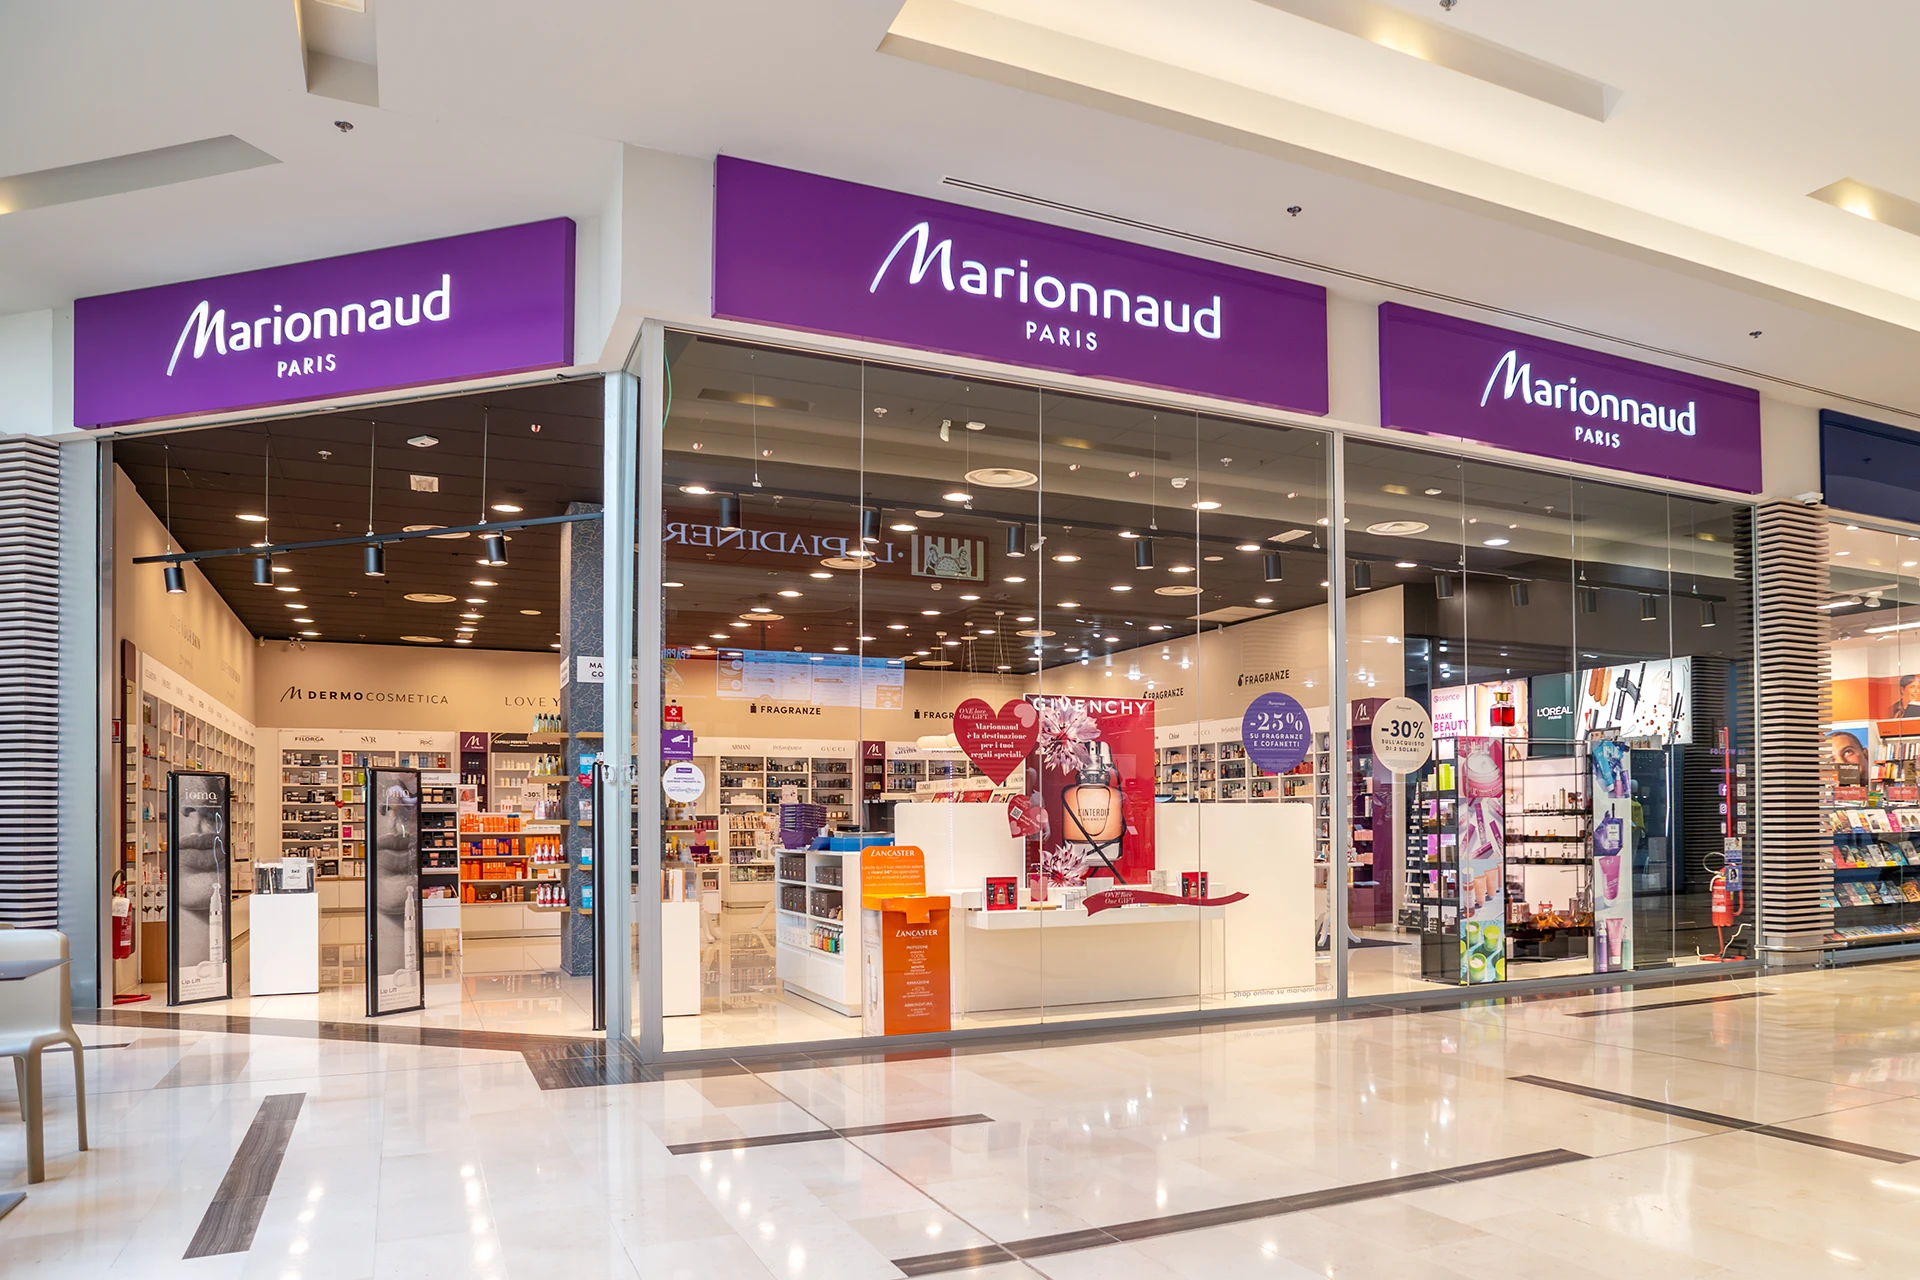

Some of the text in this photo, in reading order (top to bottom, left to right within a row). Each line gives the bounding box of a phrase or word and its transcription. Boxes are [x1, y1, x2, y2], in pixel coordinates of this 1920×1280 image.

[870, 221, 1221, 339] Marionnaud
[167, 273, 451, 378] Marionnaud
[1026, 320, 1098, 352] PARIS
[277, 353, 337, 379] PARIS
[1480, 350, 1697, 437] Marionnaud
[1575, 425, 1621, 449] PARIS
[1245, 669, 1290, 686] FRAGRANZE
[308, 690, 449, 705] DERMOCOSMETICA
[1148, 688, 1184, 700] FRAGRANZE
[1434, 693, 1460, 703] essence
[505, 696, 546, 707] LOVE
[1033, 697, 1148, 715] GIVENCHY
[761, 705, 822, 715] FRAGRANZE
[1536, 706, 1574, 717] L'ORÉAL
[1381, 720, 1425, 739] -30%
[1433, 719, 1469, 732] BEAUTY
[1382, 739, 1425, 747] SULL'ACQUISTO
[971, 751, 1024, 759] regali speciali.
[185, 789, 217, 801] ioma
[871, 849, 915, 857] LANCASTER
[895, 929, 938, 938] LANCASTER
[181, 977, 201, 986] Lip Lift
[380, 988, 388, 997] Lip
[1233, 989, 1251, 998] Shop
